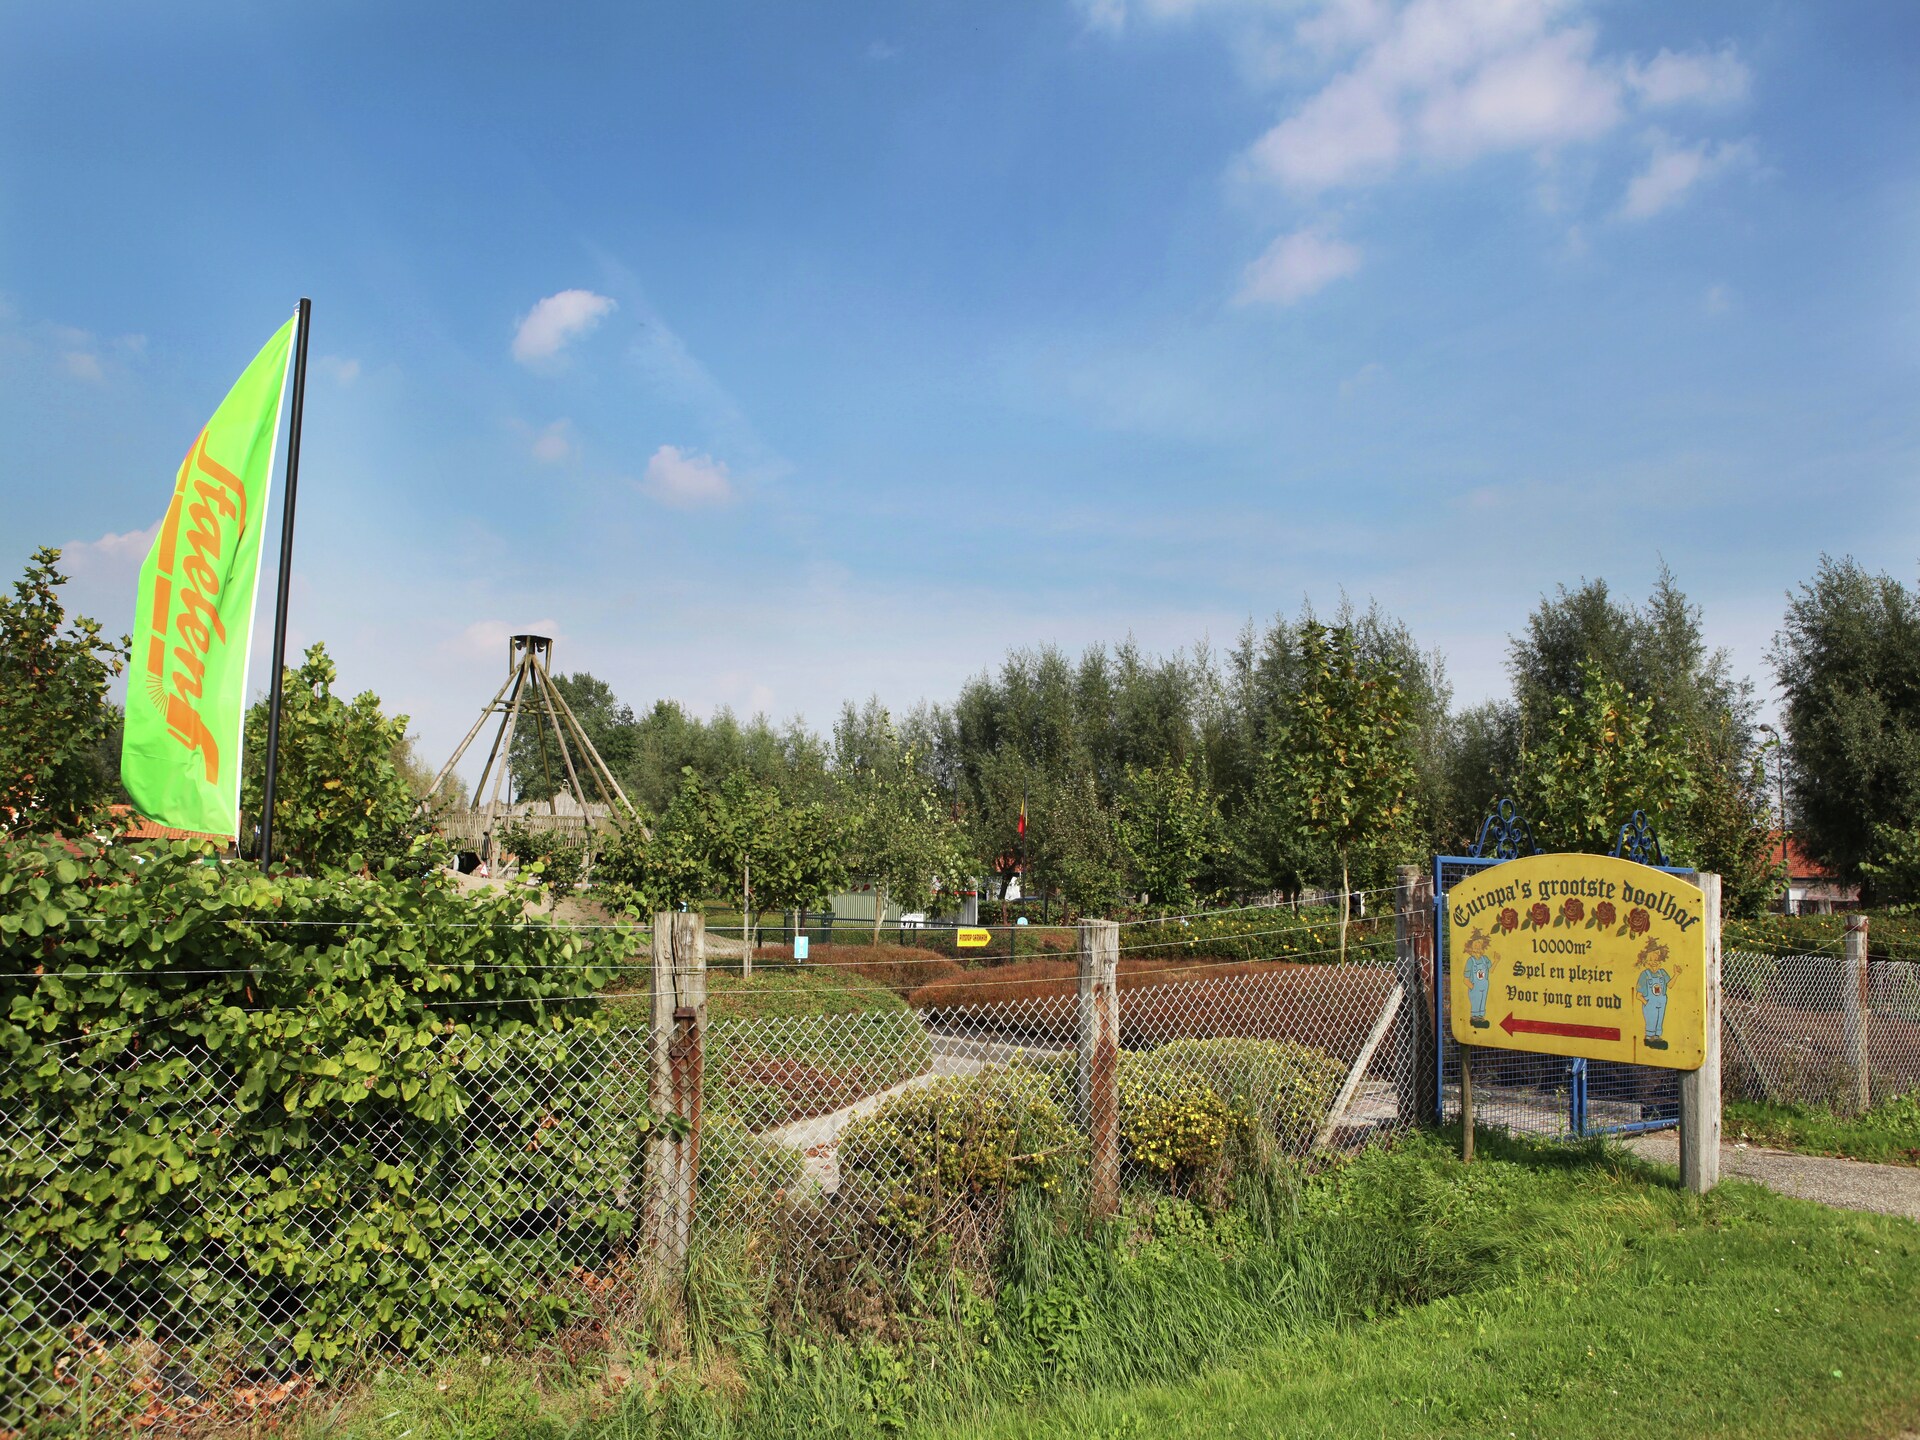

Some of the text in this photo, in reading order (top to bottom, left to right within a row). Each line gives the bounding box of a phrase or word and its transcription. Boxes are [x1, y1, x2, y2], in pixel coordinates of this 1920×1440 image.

[1453, 876, 1700, 932] Europa's grootste doolhof
[1512, 960, 1613, 984] Spel en plezier
[1506, 984, 1622, 1009] Voor jong en oud
